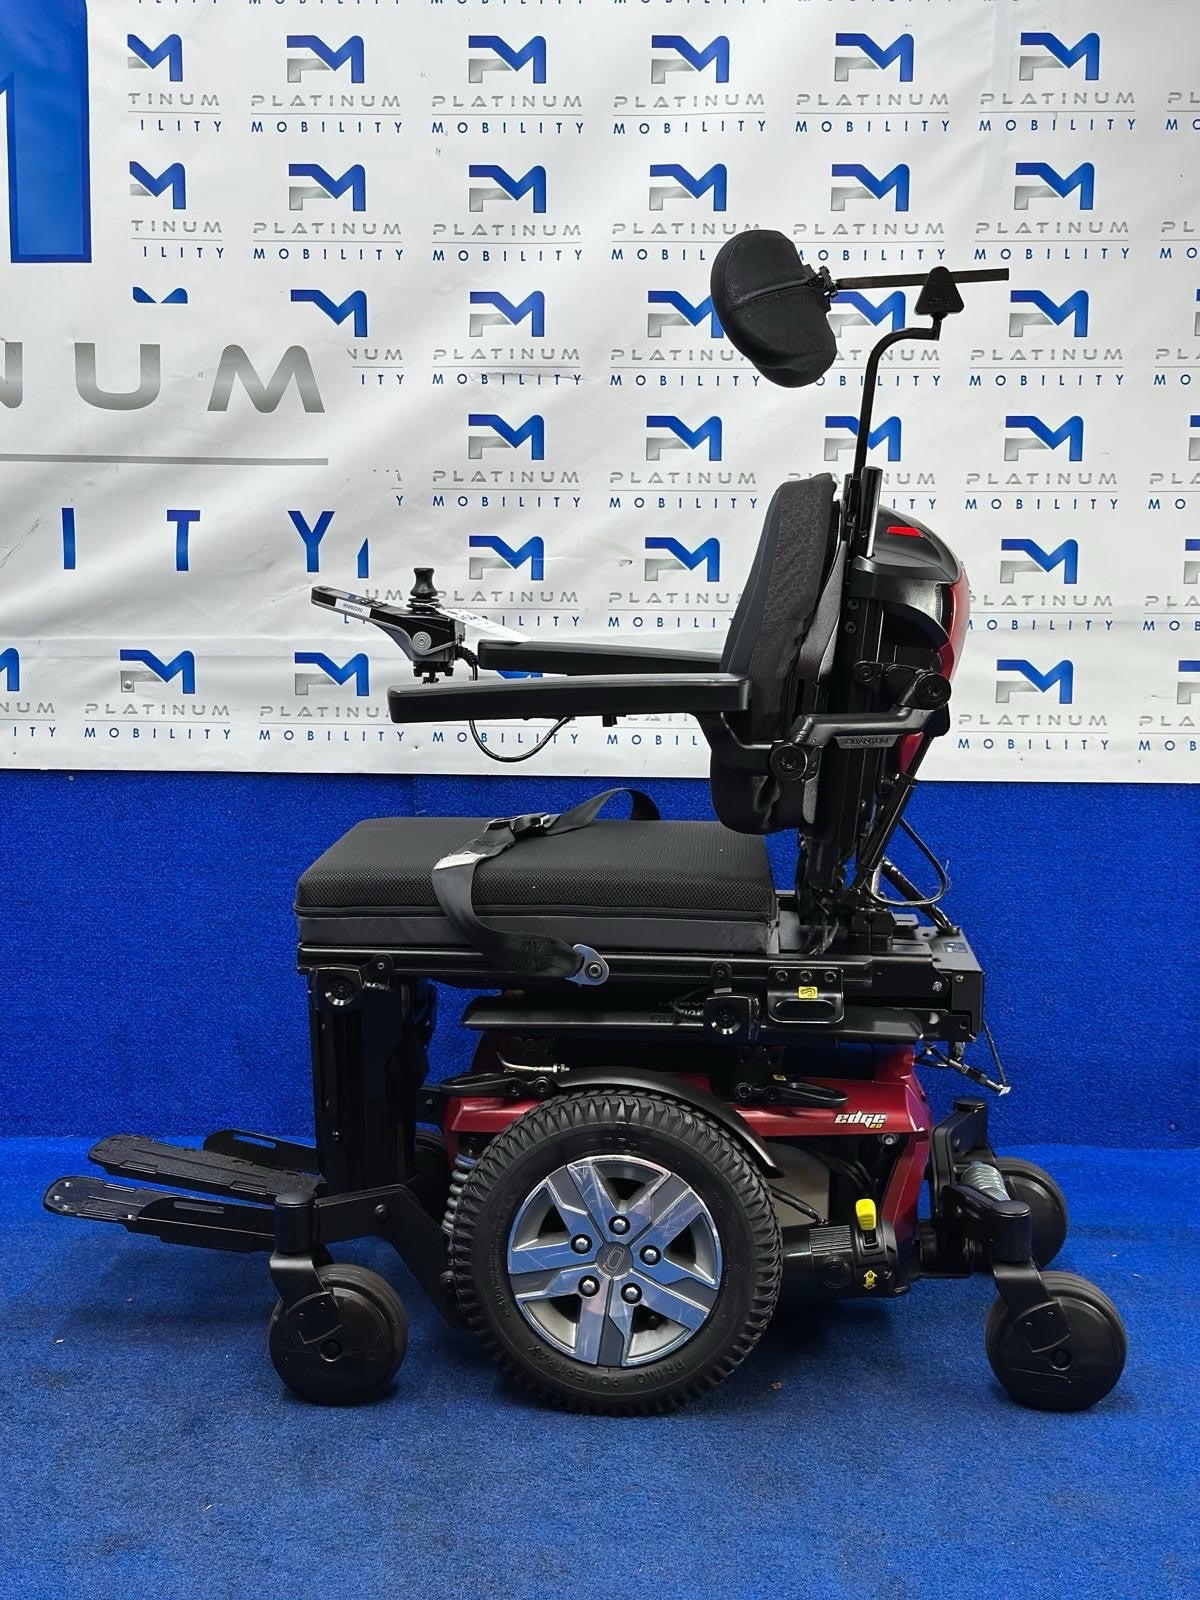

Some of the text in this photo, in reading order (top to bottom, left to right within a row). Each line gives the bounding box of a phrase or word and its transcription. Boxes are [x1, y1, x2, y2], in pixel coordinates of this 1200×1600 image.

[251, 95, 400, 107] PLATINUM
[432, 96, 582, 107] PLATINUM
[613, 93, 765, 107] PLATINUM
[796, 93, 949, 106] PLATINUM
[980, 92, 1135, 104] PLATINUM
[251, 121, 402, 133] MOBILITY
[432, 122, 583, 134] MOBILITY
[613, 120, 766, 134] MOBILITY
[795, 120, 949, 132] MOBILITY
[979, 119, 1136, 131] MOBILITY
[253, 223, 401, 235] PLATINUM
[433, 224, 580, 236] PLATINUM
[793, 223, 944, 235] PLATINUM
[976, 222, 1128, 234] PLATINUM
[254, 248, 403, 260] MOBILITY
[433, 250, 582, 262] MOBILITY
[611, 249, 706, 260] MOBIL
[974, 248, 1129, 260] MOBILITY
[432, 348, 581, 361] PLATINUM
[611, 349, 746, 361] PLATINU
[971, 349, 1123, 360] PLATINUM
[432, 373, 582, 386] MOBILITY
[610, 375, 760, 386] MOBILITY
[815, 375, 941, 386] OBILITY
[969, 375, 1124, 386] MOBILITY
[433, 470, 579, 483] PLATINUM
[610, 472, 756, 484] PLATINUM
[966, 473, 1117, 484] PLATINUM
[433, 496, 580, 507] MOBILITY
[609, 497, 757, 509] MOBILITY
[965, 499, 1118, 509] MOBILITY
[608, 592, 742, 604] PLATINU
[608, 617, 733, 628] MOBILI
[85, 703, 229, 716] PLATINUM
[259, 704, 389, 718] PLATINU
[959, 714, 1107, 726] PLATINUM
[84, 727, 230, 739] MOBILITY
[259, 730, 404, 742] MOBILITY
[432, 732, 580, 743] MOBILITY
[606, 735, 699, 746] MOBIL
[958, 739, 1108, 750] MOBILITY
[834, 1110, 887, 1128] edge
